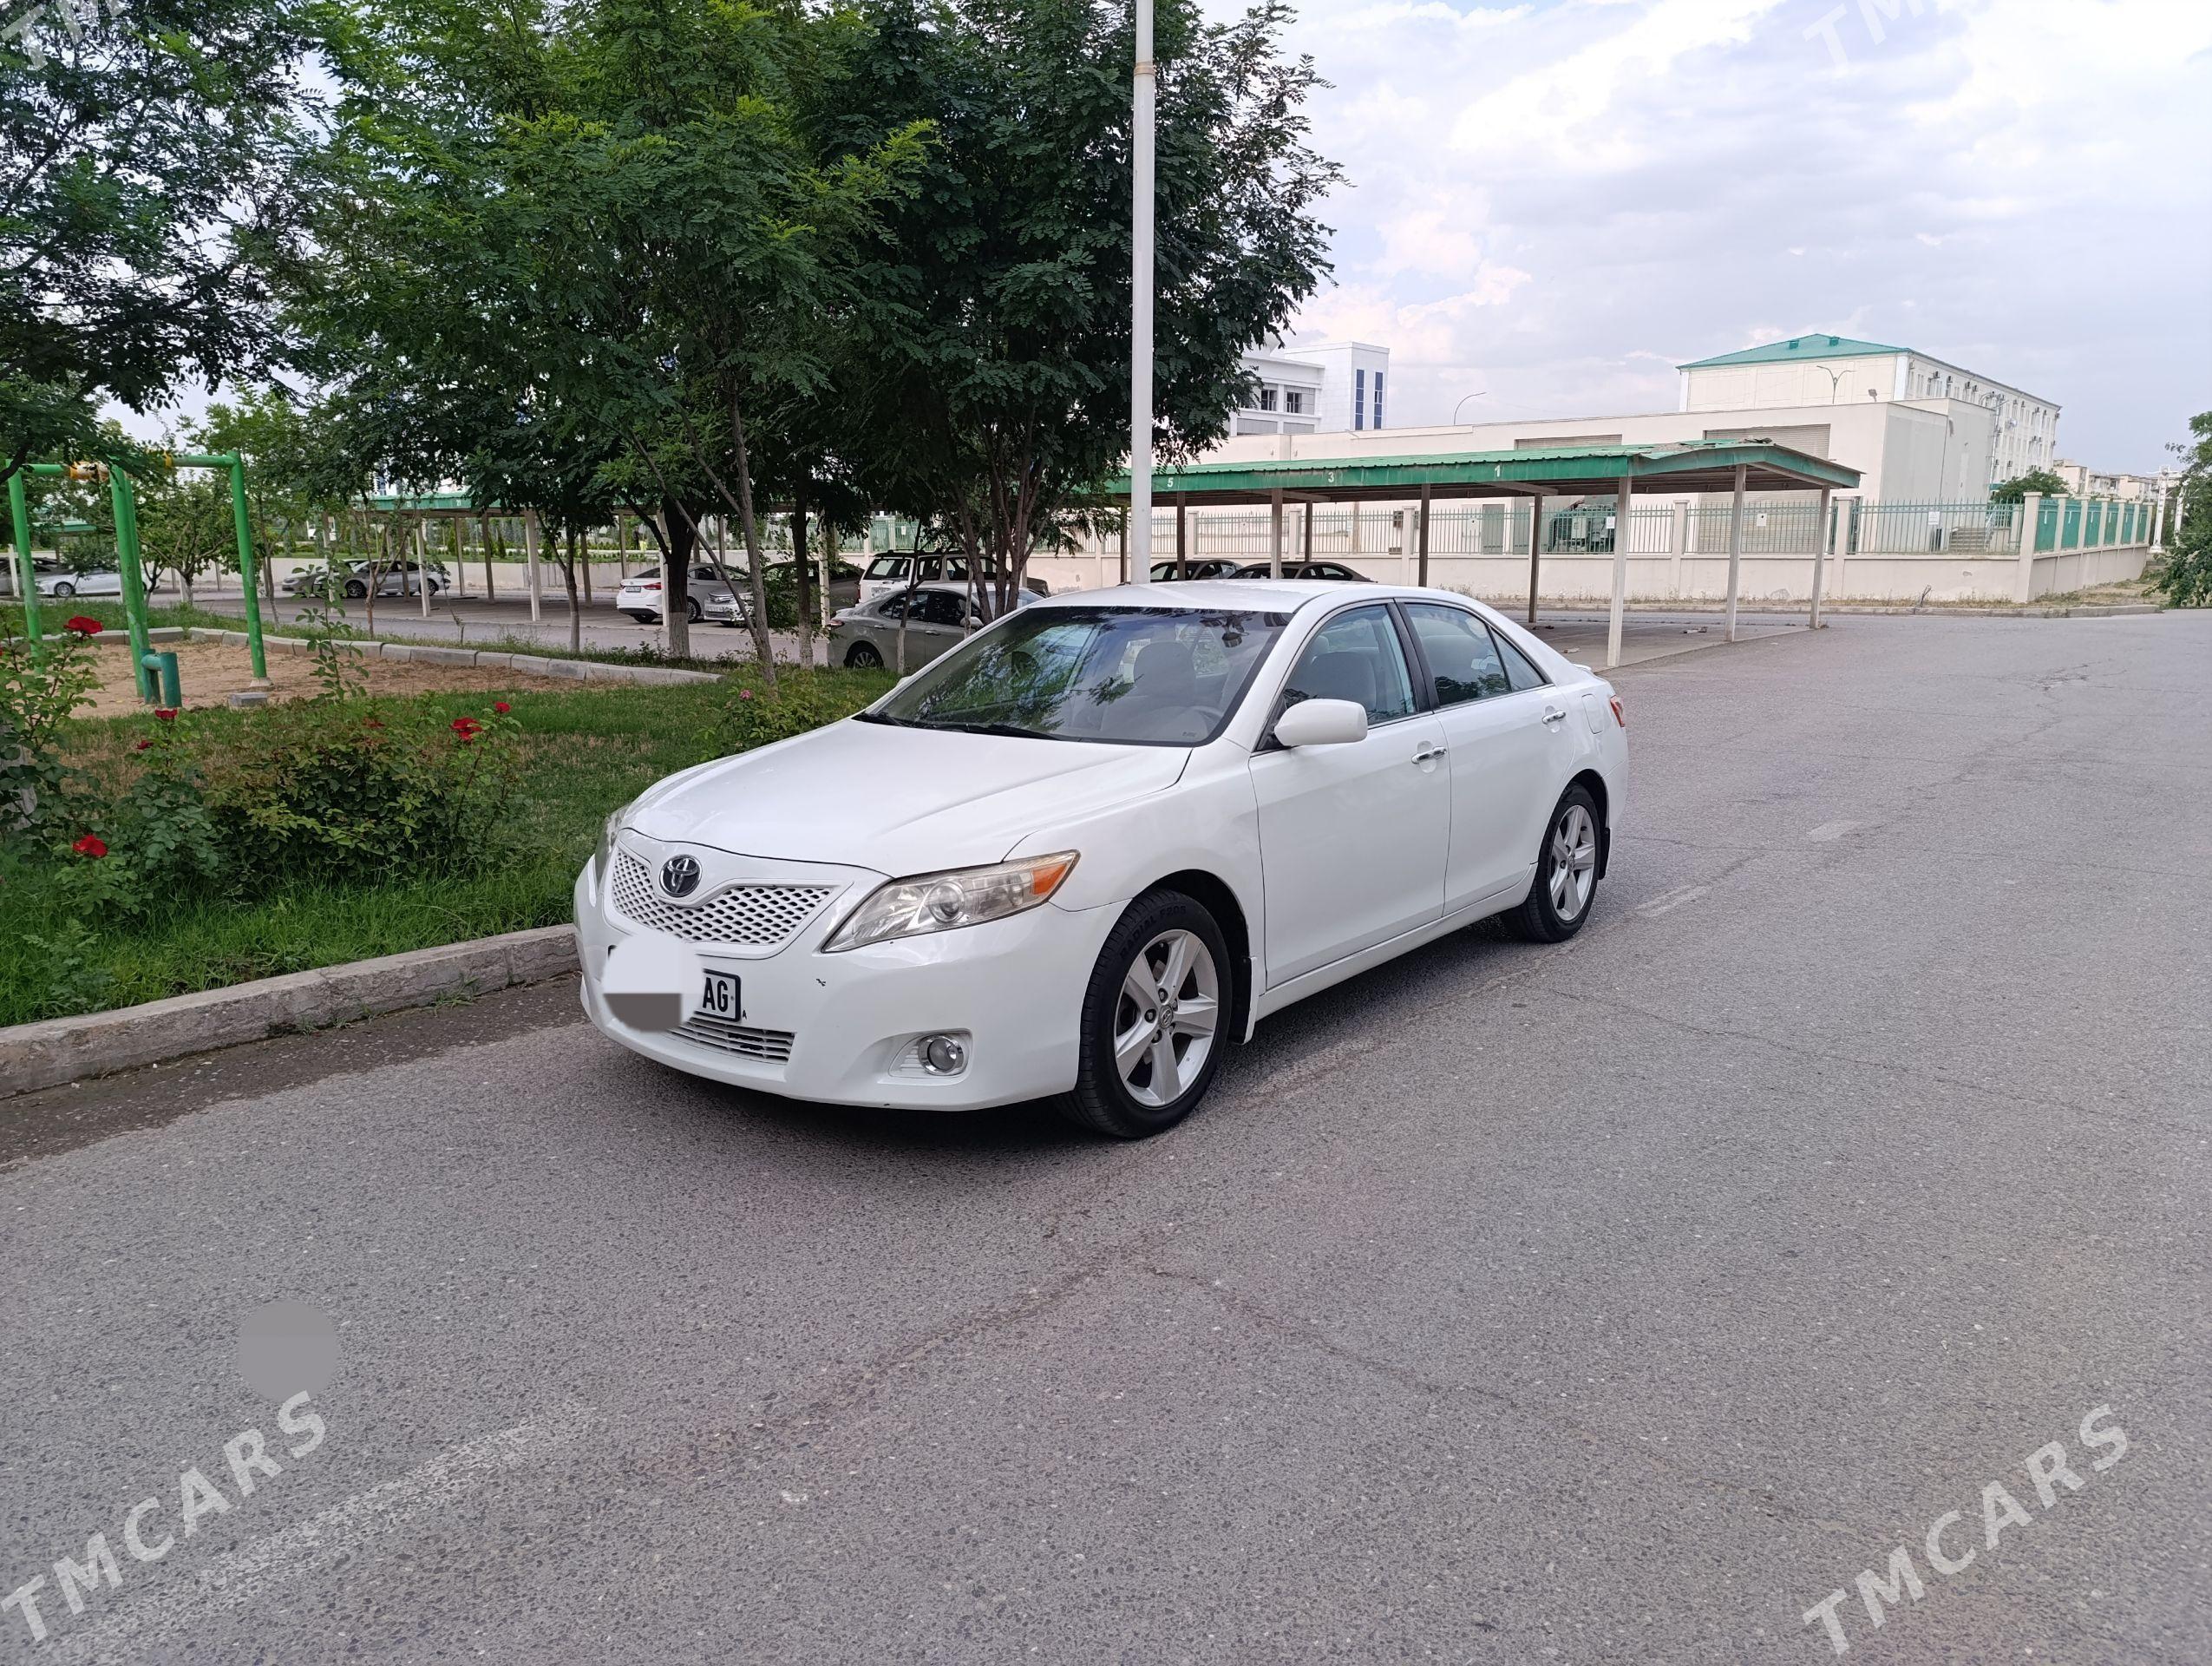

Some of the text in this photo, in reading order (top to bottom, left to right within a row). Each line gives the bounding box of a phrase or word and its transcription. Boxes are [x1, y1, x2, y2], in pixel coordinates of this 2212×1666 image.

[1495, 465, 1500, 476] 1
[1167, 477, 1173, 487] 5
[1328, 471, 1334, 482] 3
[1120, 915, 1157, 959] RADIAL
[703, 977, 729, 1012] AG
